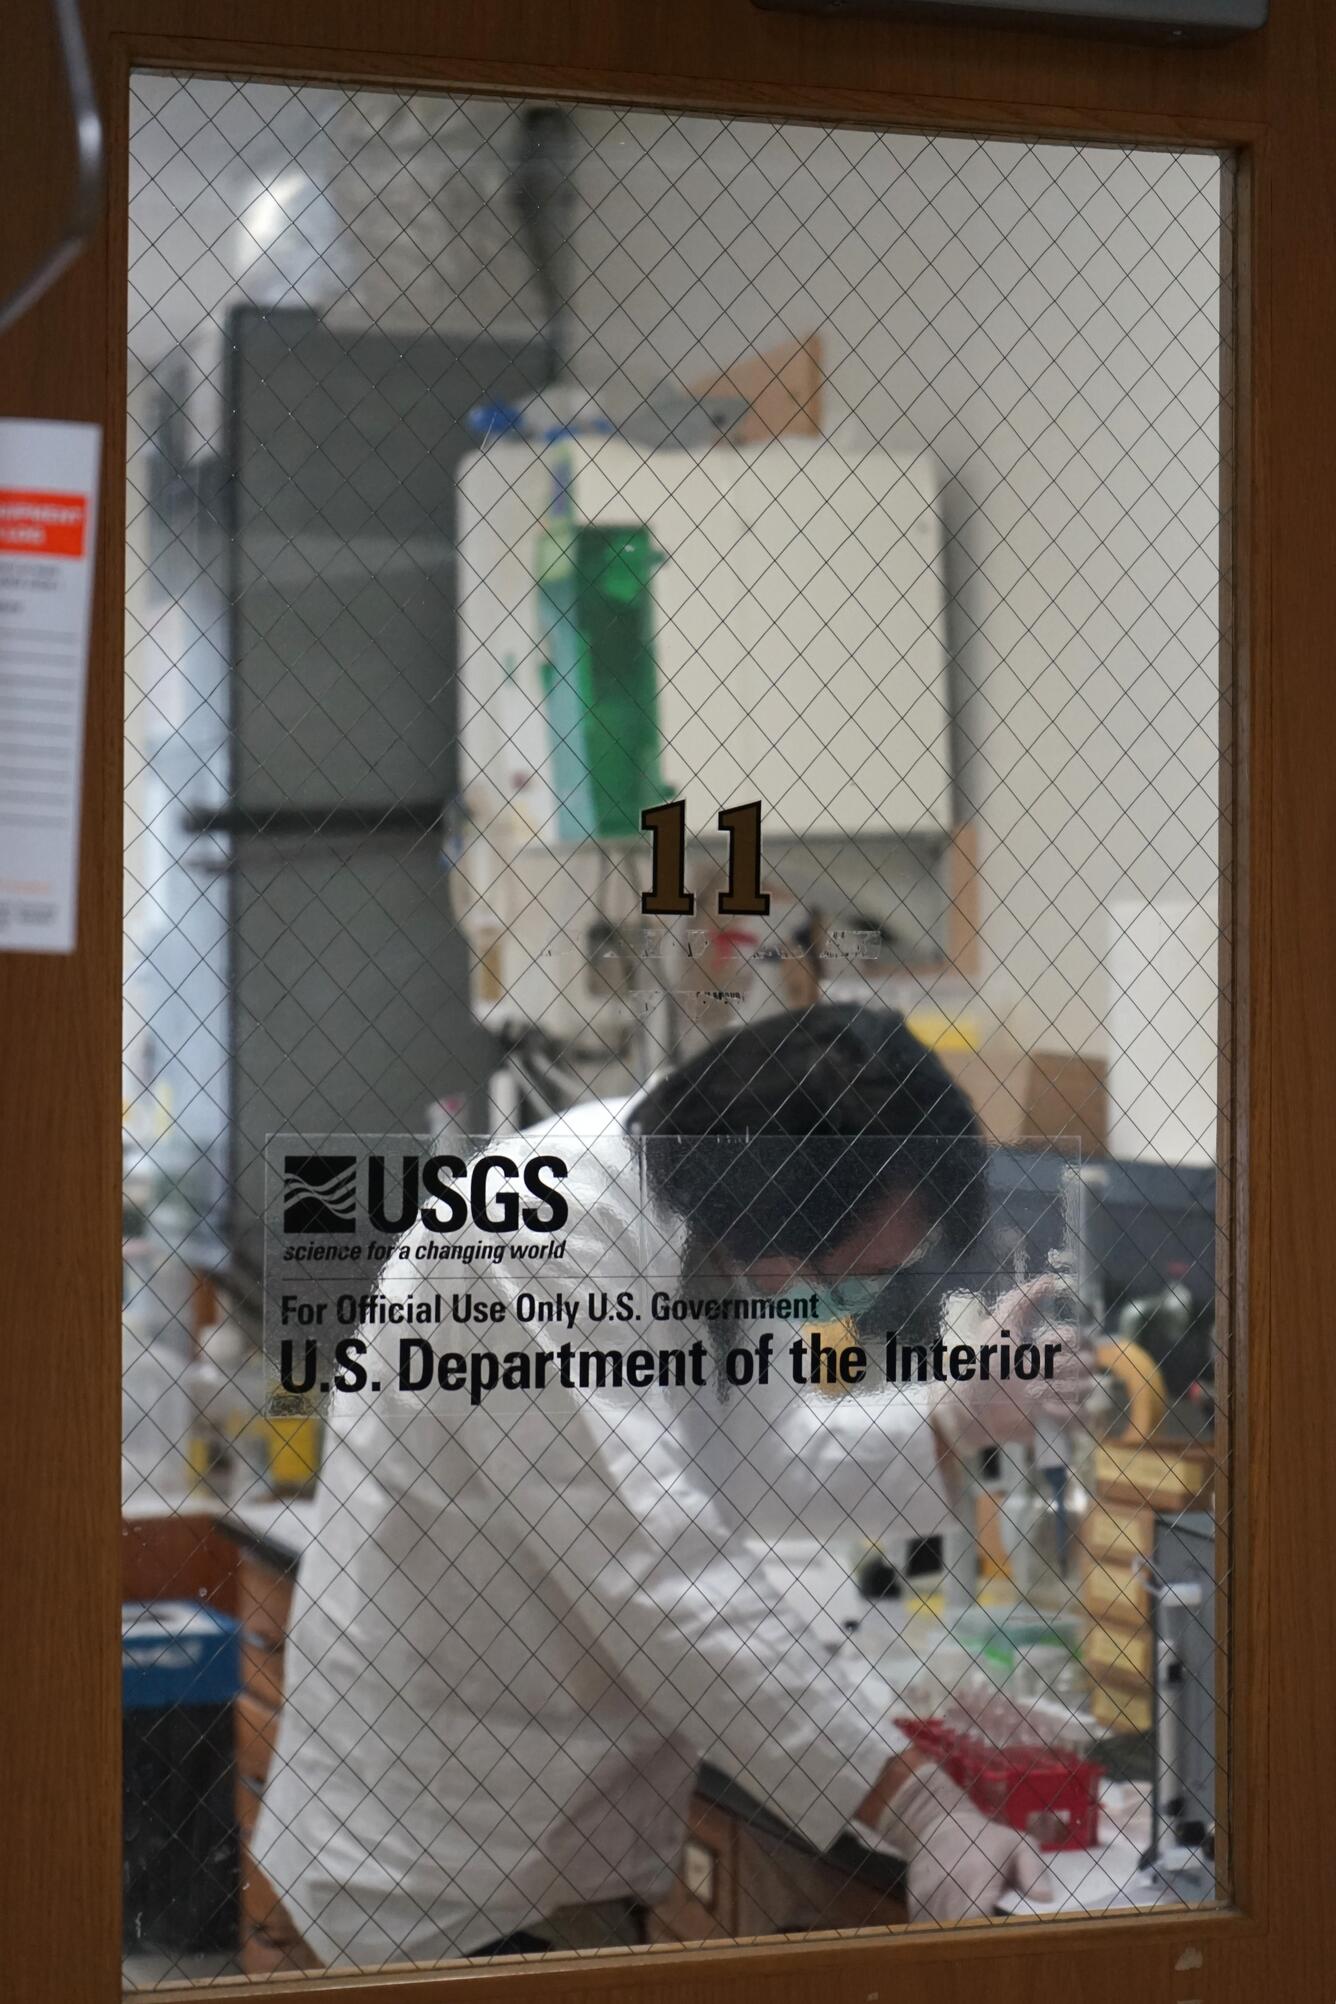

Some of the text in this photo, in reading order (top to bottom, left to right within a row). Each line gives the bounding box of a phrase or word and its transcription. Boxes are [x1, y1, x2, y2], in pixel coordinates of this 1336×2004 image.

[641, 800, 770, 916] 11
[368, 1155, 568, 1233] USGS
[283, 1240, 567, 1264] science for a changing world
[282, 1292, 819, 1328] For Official Use Only U.S. Government
[280, 1329, 1062, 1405] U.S. Department of the Interior
